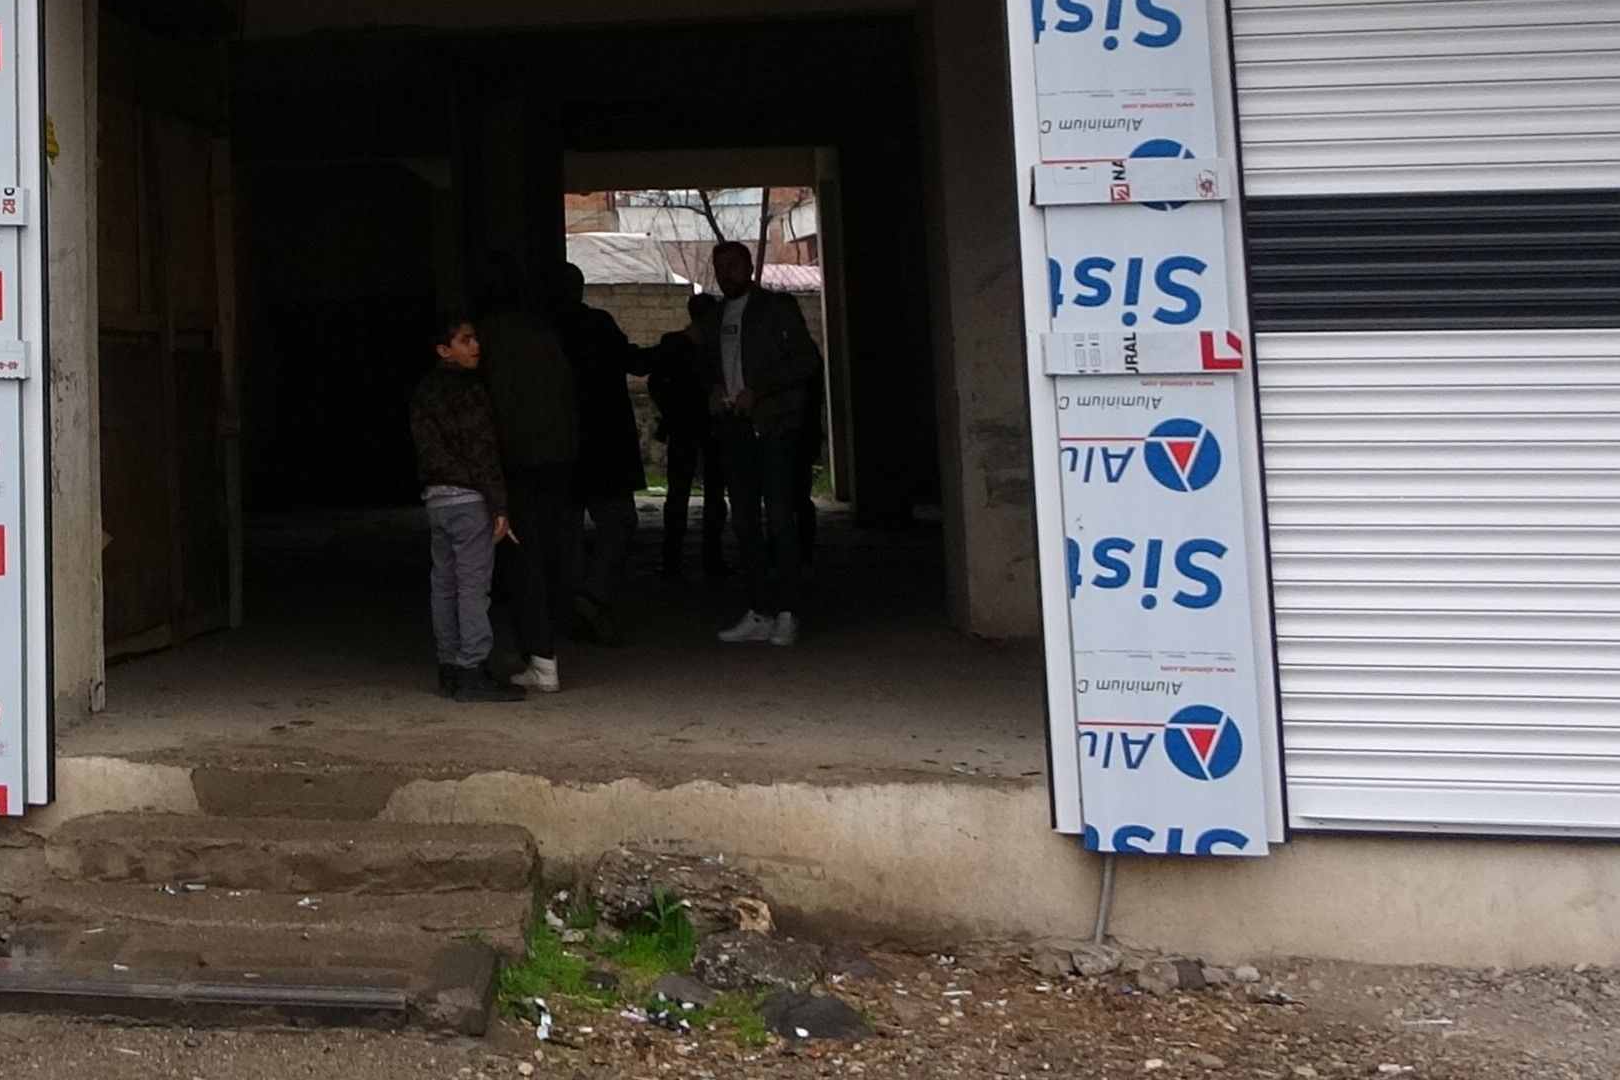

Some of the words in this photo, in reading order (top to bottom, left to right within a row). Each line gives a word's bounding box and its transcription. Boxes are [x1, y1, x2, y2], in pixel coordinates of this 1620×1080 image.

[1058, 117, 1144, 132] Aluminium
[1076, 395, 1163, 410] Aluminium
[1095, 679, 1184, 695] Aluminium
